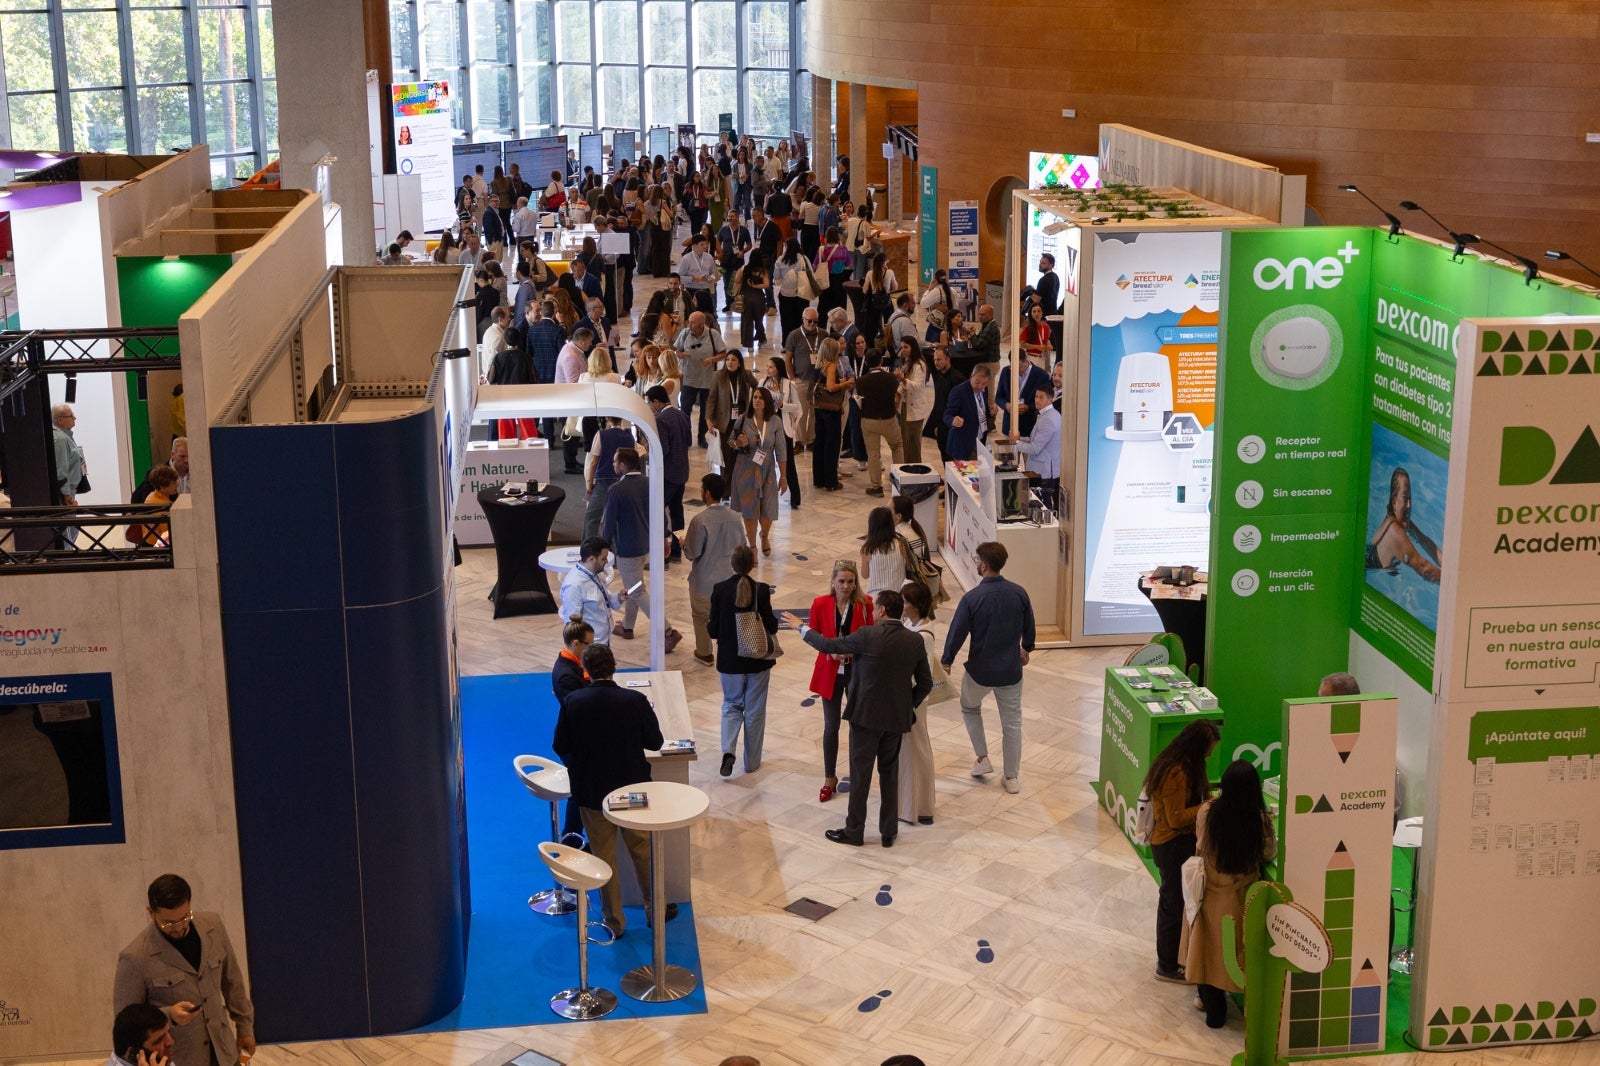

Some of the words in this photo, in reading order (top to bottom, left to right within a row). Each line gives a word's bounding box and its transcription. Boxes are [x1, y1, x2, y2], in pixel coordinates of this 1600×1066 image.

[1378, 298, 1449, 351] Dexcom
[1376, 346, 1394, 367] Para
[1396, 356, 1408, 374] tus
[1410, 364, 1450, 393] pacientes
[1374, 373, 1388, 388] con
[1390, 377, 1426, 406] diabetes
[1427, 395, 1444, 415] tipo
[1446, 401, 1452, 418] 2
[1373, 393, 1420, 428] tratamiento
[1422, 418, 1437, 437] con
[1276, 436, 1320, 446] Receptor
[1274, 452, 1288, 460] en
[1290, 449, 1325, 460] tiempo
[1328, 448, 1347, 458] real
[482, 464, 528, 476] Nature.
[1273, 488, 1288, 498] Sin
[1291, 488, 1332, 496] escaneo
[1269, 568, 1313, 579] Inserción
[1268, 584, 1281, 592] en
[1284, 584, 1296, 592] un
[1298, 582, 1315, 591] clic
[4, 604, 20, 616] de
[1482, 621, 1535, 634] Prueba
[1540, 622, 1558, 632] un
[1486, 643, 1504, 652] en
[1509, 640, 1565, 652] nuestra
[1505, 656, 1576, 670] formativa
[1485, 730, 1551, 745] ¡Apúntate
[1554, 728, 1587, 742] aquí!
[1117, 737, 1138, 768] diabetes
[1340, 789, 1386, 800] Dexcom
[1340, 801, 1386, 811] Academy
